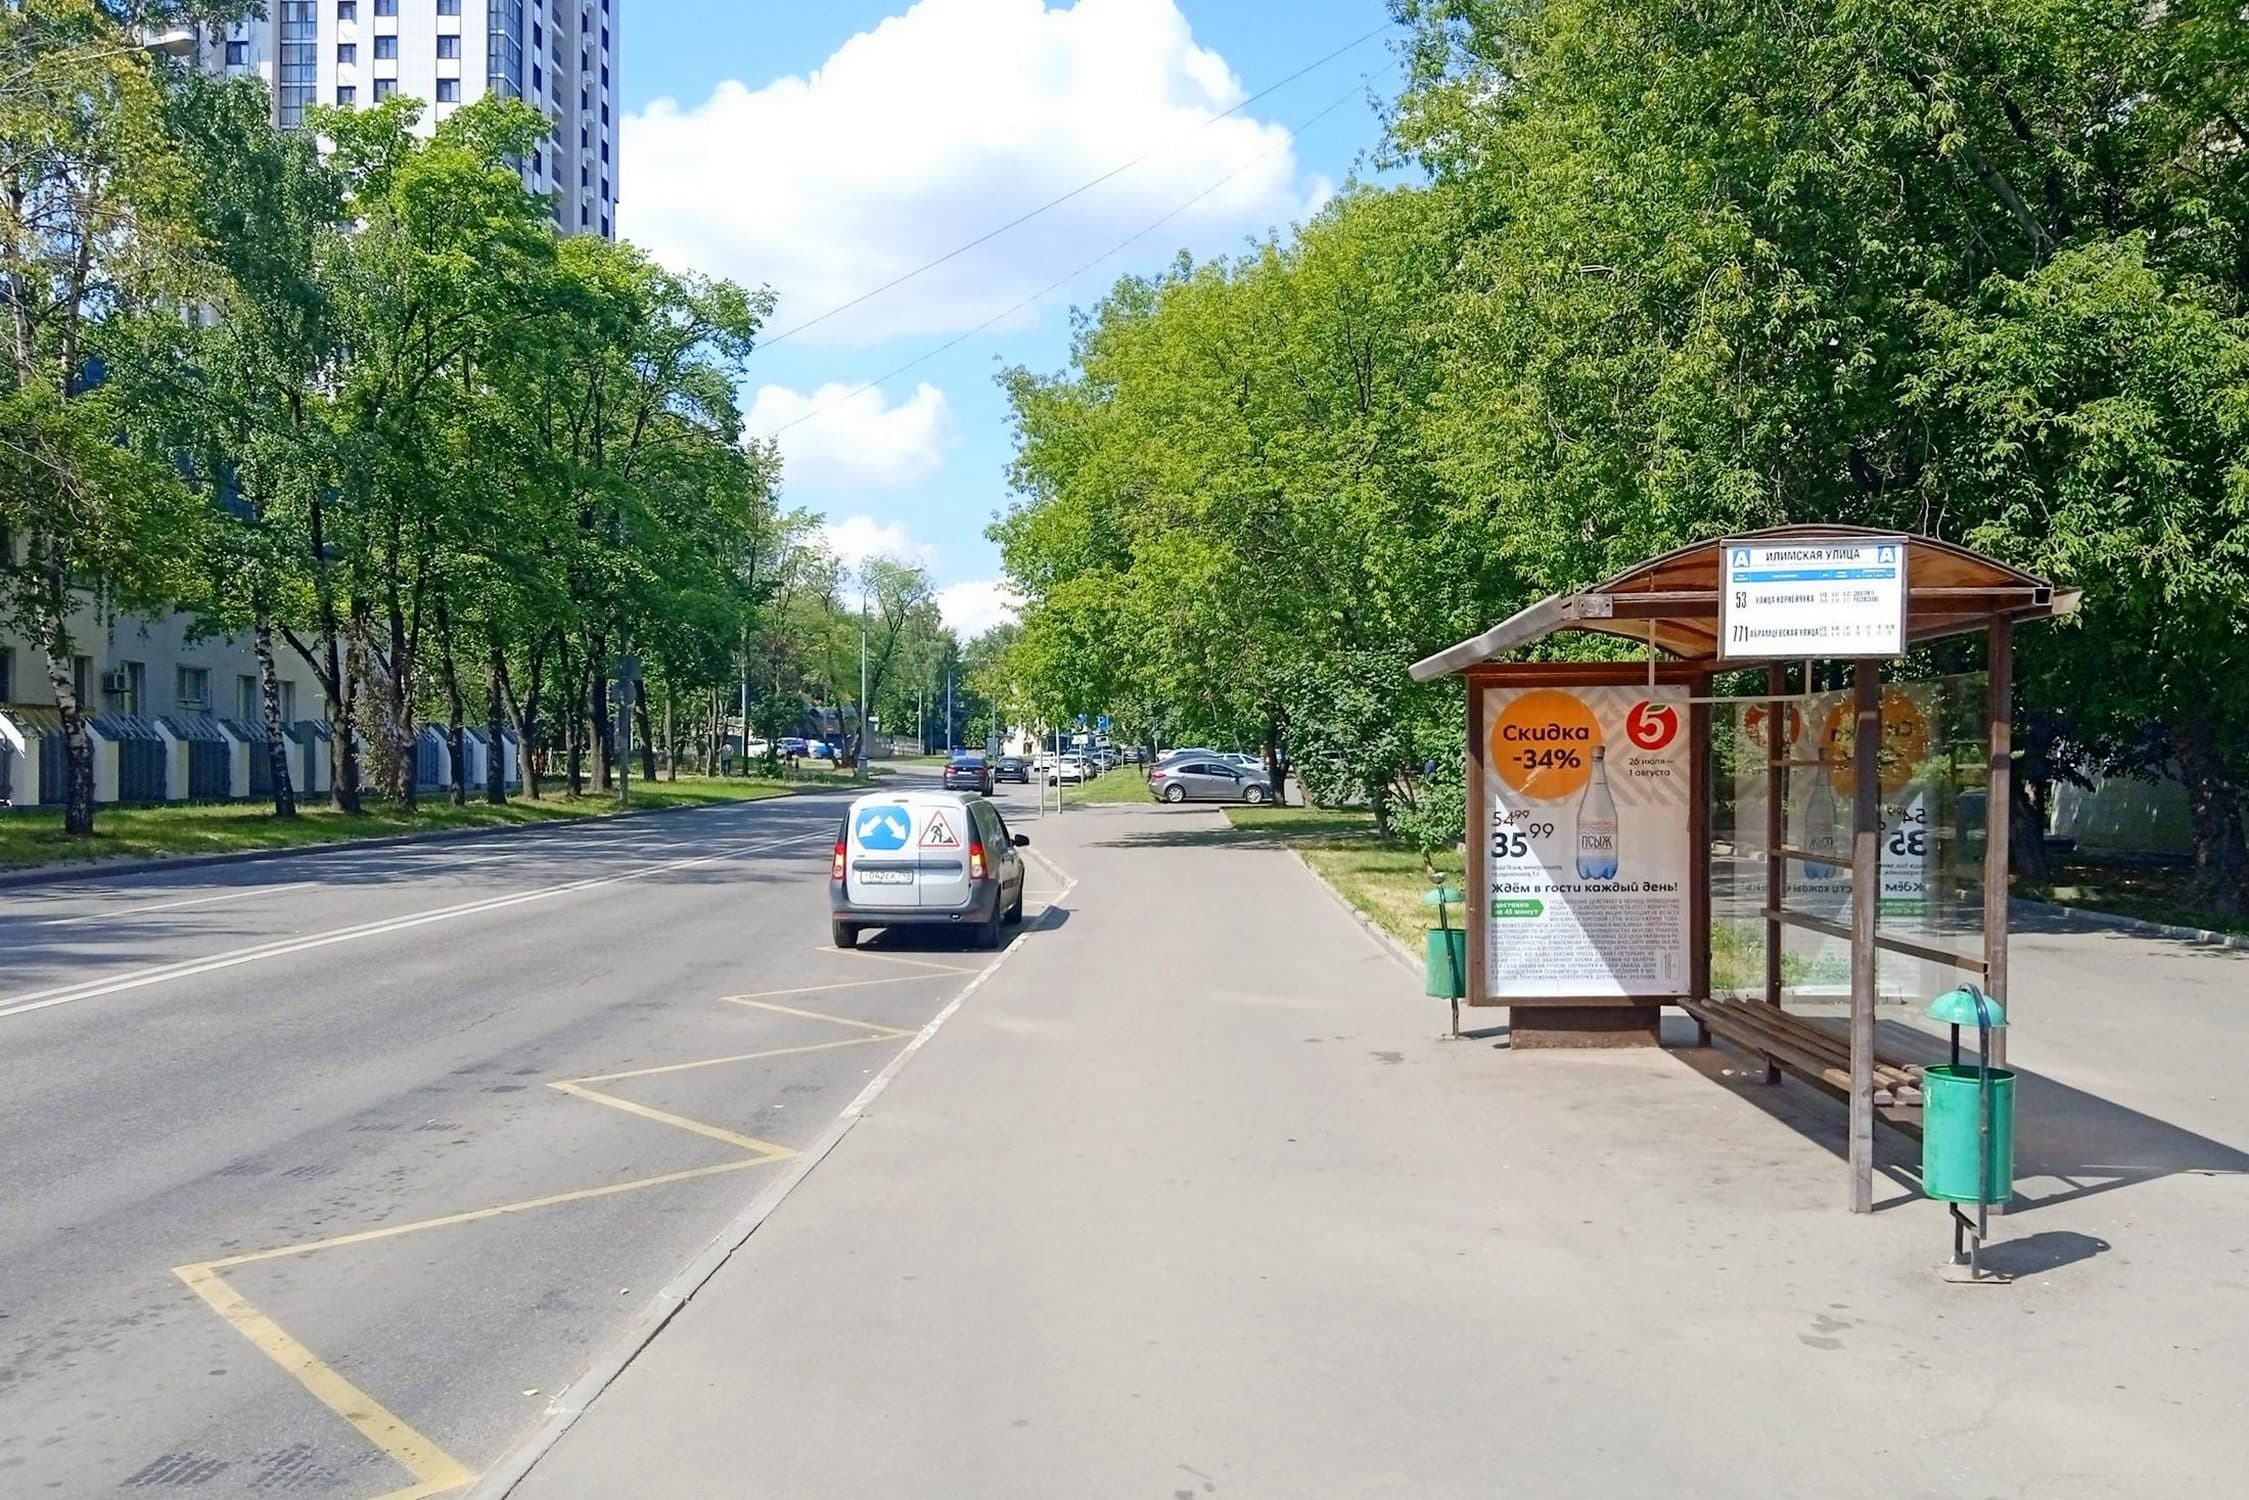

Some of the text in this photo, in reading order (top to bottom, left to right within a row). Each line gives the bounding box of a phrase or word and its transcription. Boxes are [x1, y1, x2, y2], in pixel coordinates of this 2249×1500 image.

[1766, 549, 1861, 562] ИЛИМСКАЯ УЛИЦА
[1736, 592, 1747, 609] 53
[1733, 625, 1749, 642] 771
[1503, 723, 1590, 741] Скидка
[1513, 748, 1581, 770] -34%
[1628, 757, 1640, 766] 26
[1635, 769, 1671, 778] августа
[1581, 835, 1612, 849] ПСЫЖ
[1491, 881, 1678, 893] Ждём в гости каждый день!
